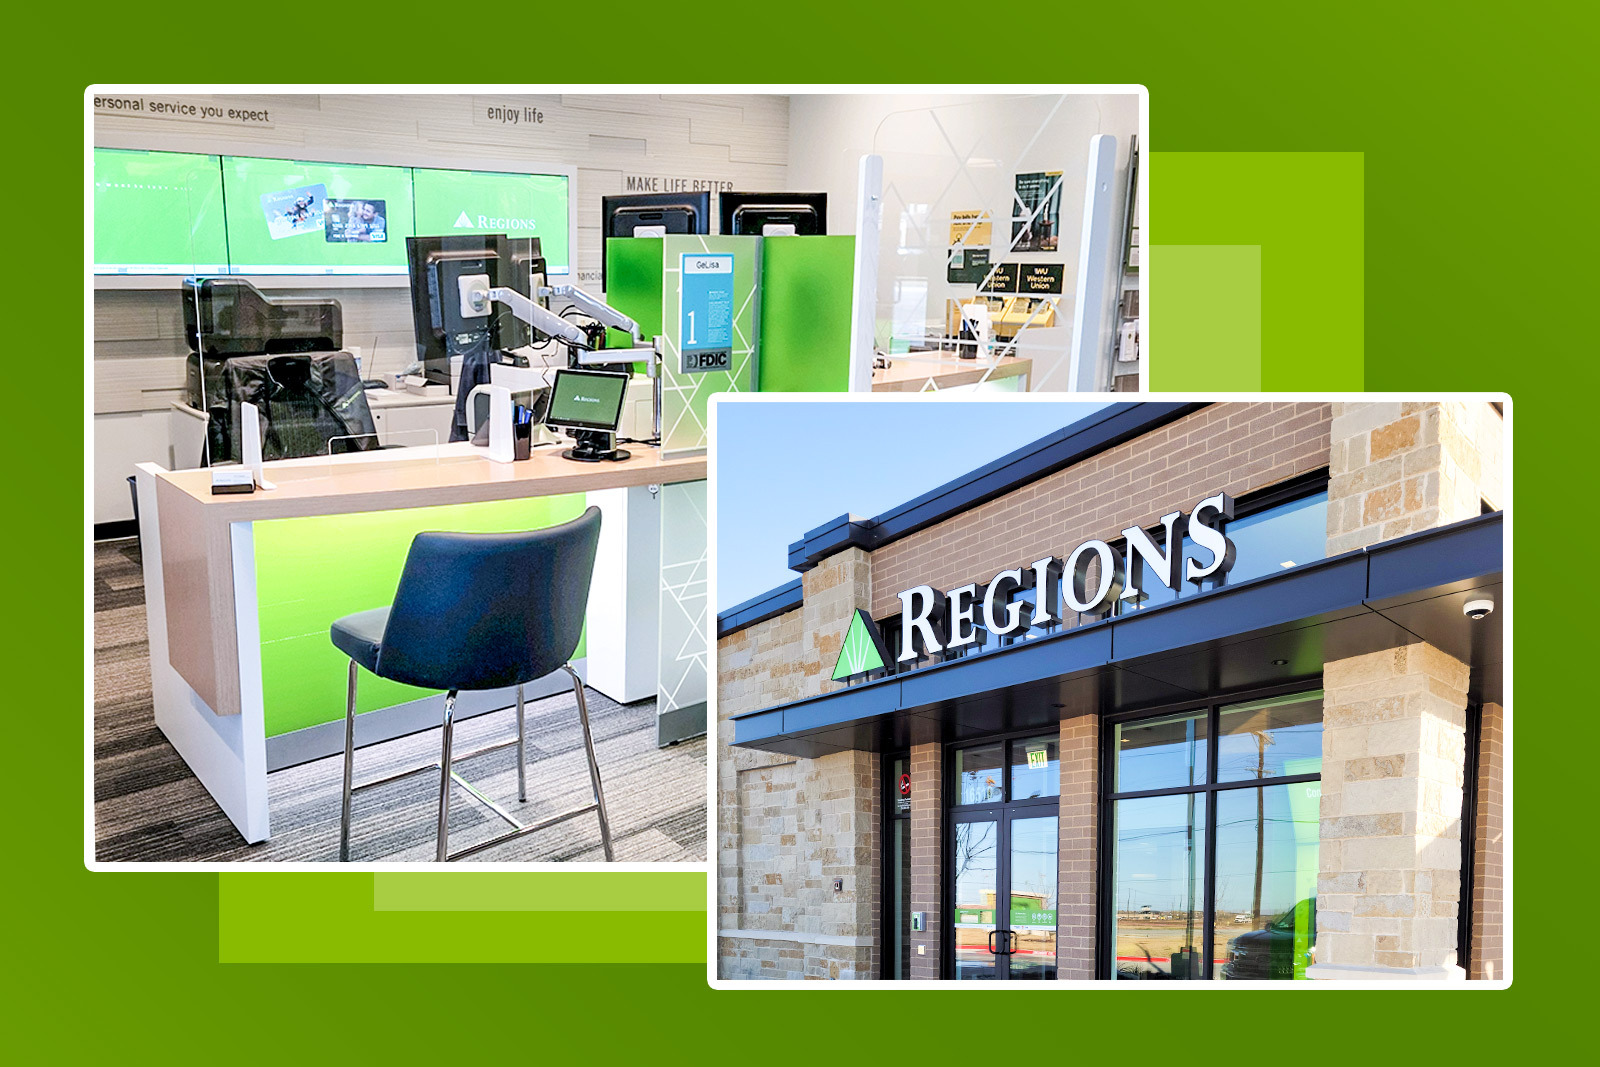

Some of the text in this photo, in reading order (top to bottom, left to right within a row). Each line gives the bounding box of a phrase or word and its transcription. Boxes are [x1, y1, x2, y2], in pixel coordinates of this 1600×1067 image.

[94, 96, 269, 122] ersonal service you expect
[487, 105, 544, 124] enjoy life
[626, 176, 734, 193] MAKE LIFE BETTER
[477, 214, 536, 230] REGIONS
[696, 261, 719, 269] GeLisa
[983, 274, 1010, 282] stern
[1026, 275, 1055, 283] Western
[1030, 281, 1050, 289] Union
[687, 310, 697, 345] 1
[699, 352, 727, 367] FDIC
[897, 492, 1232, 663] REGIONS
[1030, 752, 1045, 768] EXIT
